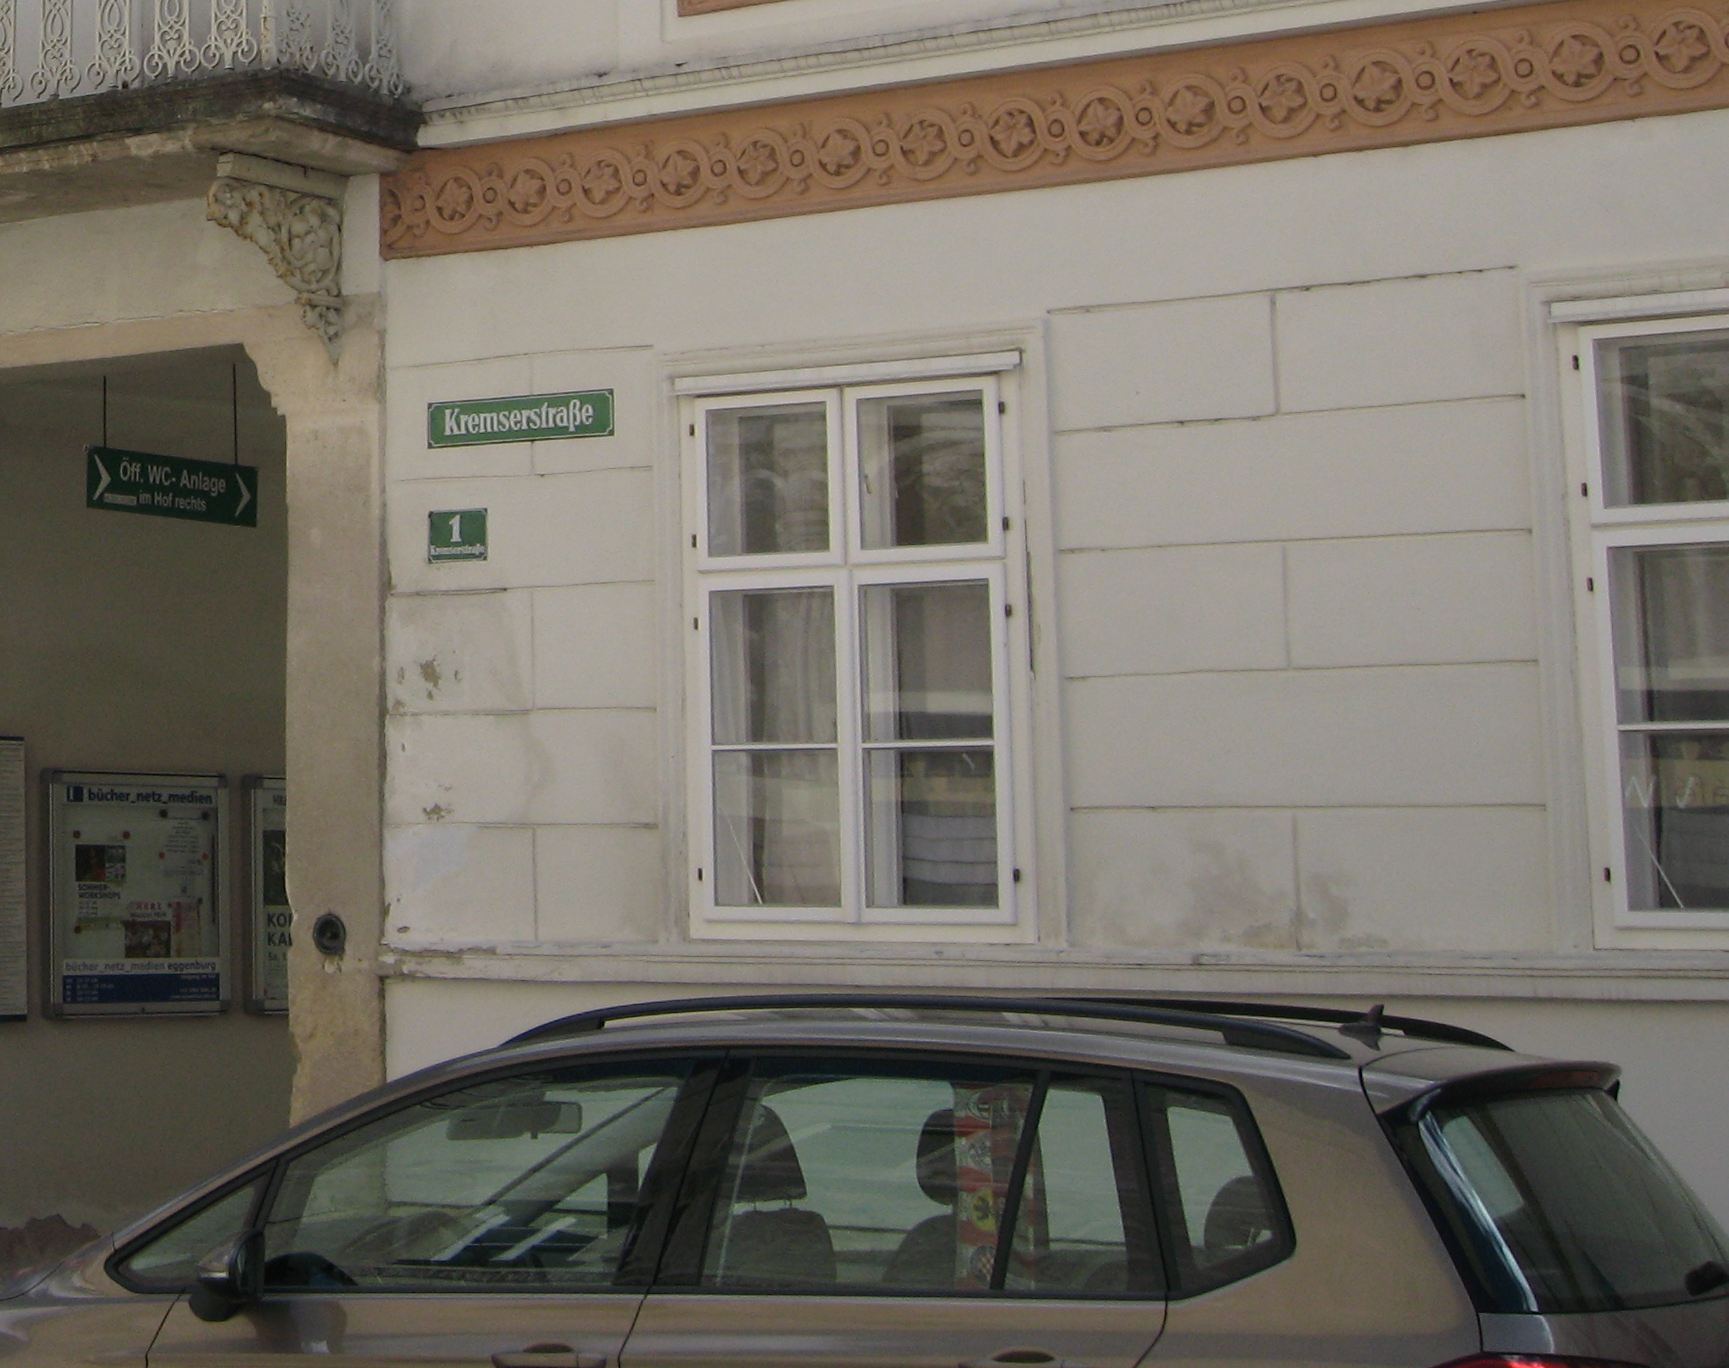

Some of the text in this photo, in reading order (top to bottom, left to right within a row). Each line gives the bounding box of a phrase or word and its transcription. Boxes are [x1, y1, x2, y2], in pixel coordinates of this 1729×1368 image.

[444, 399, 594, 436] Kremserstraße
[119, 456, 227, 496] Öff. WC- Anlage
[139, 490, 152, 505] im
[154, 491, 173, 507] Hof
[175, 496, 207, 512] rechts
[448, 514, 463, 543] 1
